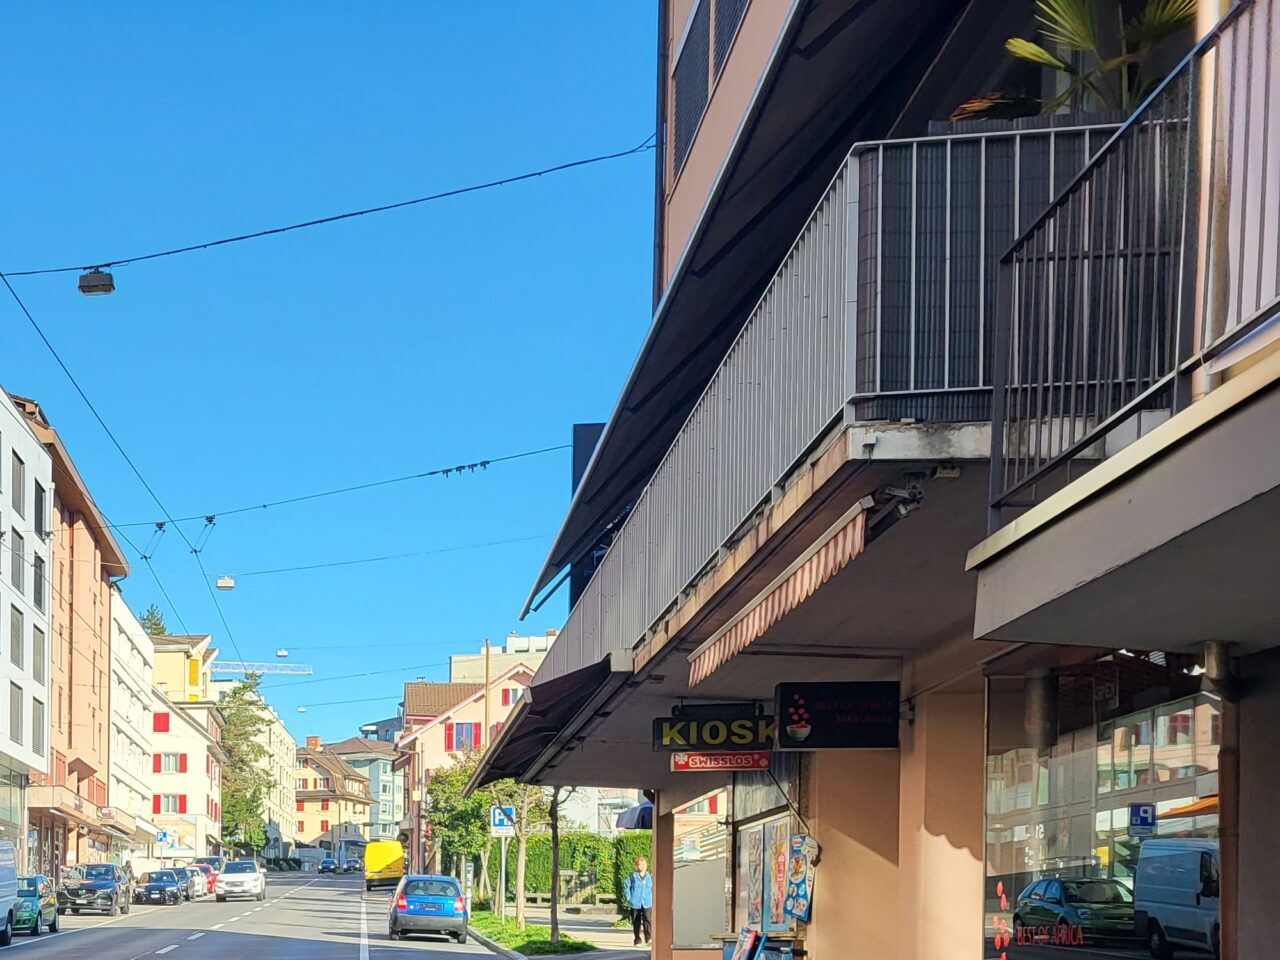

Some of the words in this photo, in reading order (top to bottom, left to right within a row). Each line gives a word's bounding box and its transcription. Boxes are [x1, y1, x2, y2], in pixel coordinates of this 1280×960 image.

[661, 719, 774, 745] KIOSK
[690, 755, 753, 767] SWISSLOS
[1017, 926, 1035, 945] BEST
[1037, 926, 1050, 944] OF
[1051, 925, 1084, 945] AFRICA
